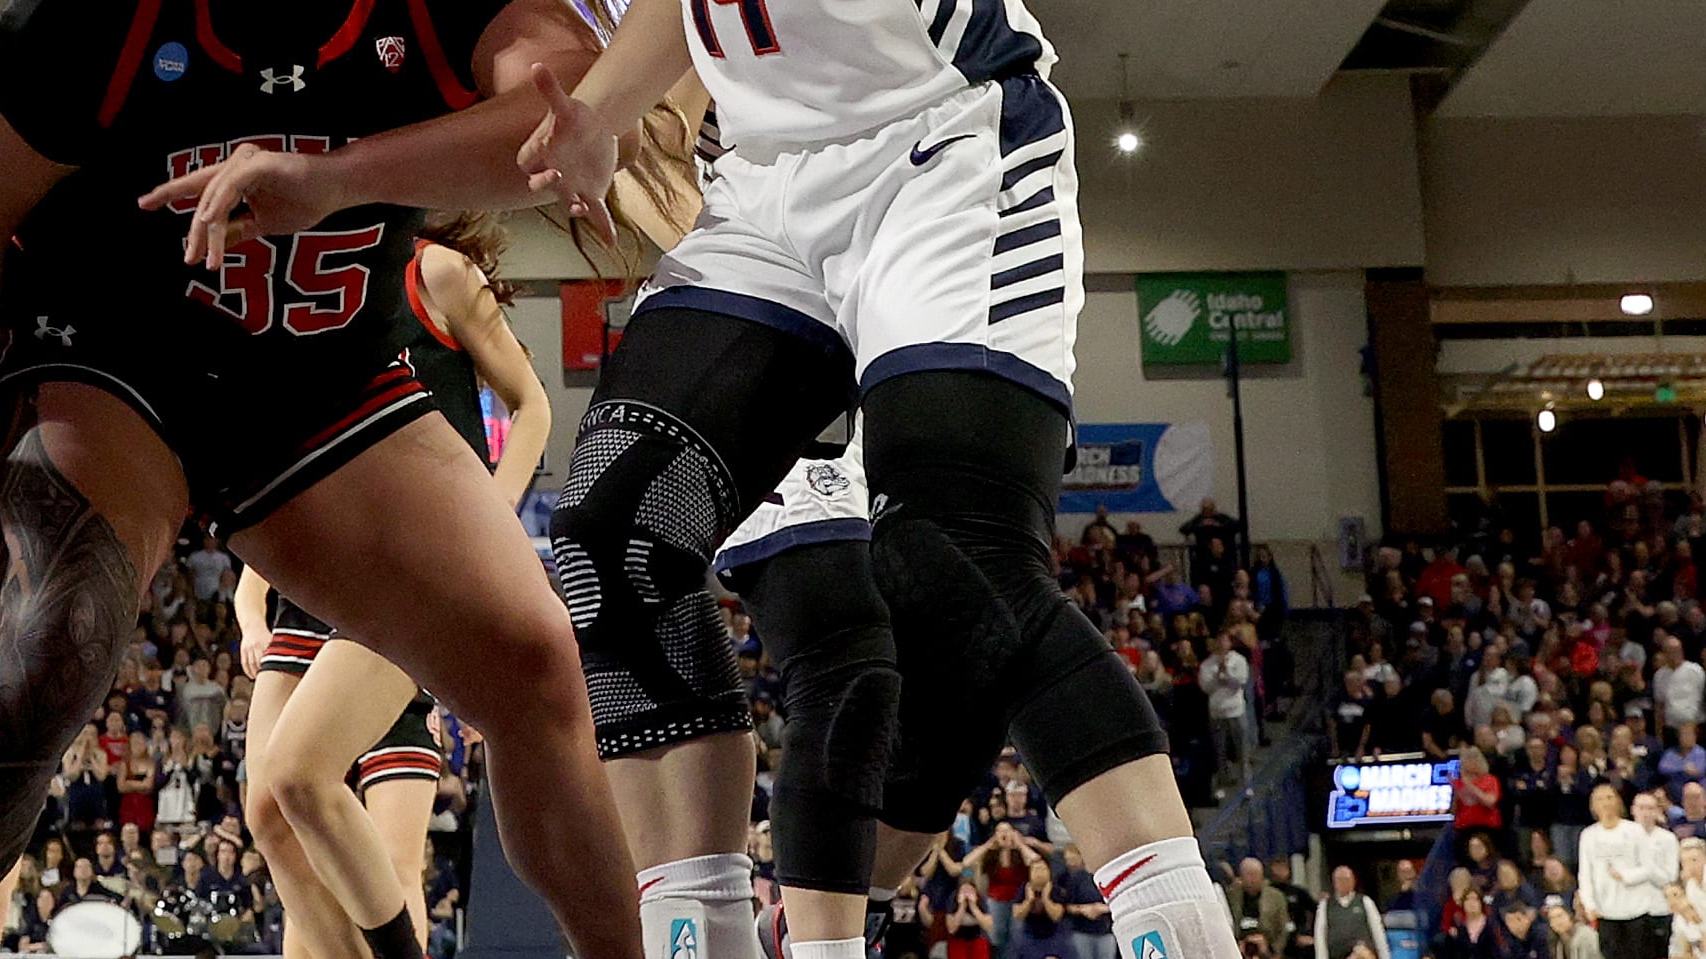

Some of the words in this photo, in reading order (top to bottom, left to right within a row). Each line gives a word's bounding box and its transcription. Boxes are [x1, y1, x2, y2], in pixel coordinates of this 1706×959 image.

[376, 36, 405, 60] PAC
[183, 223, 386, 336] 35
[1207, 292, 1263, 311] Idaho
[1359, 763, 1432, 791] MARCH
